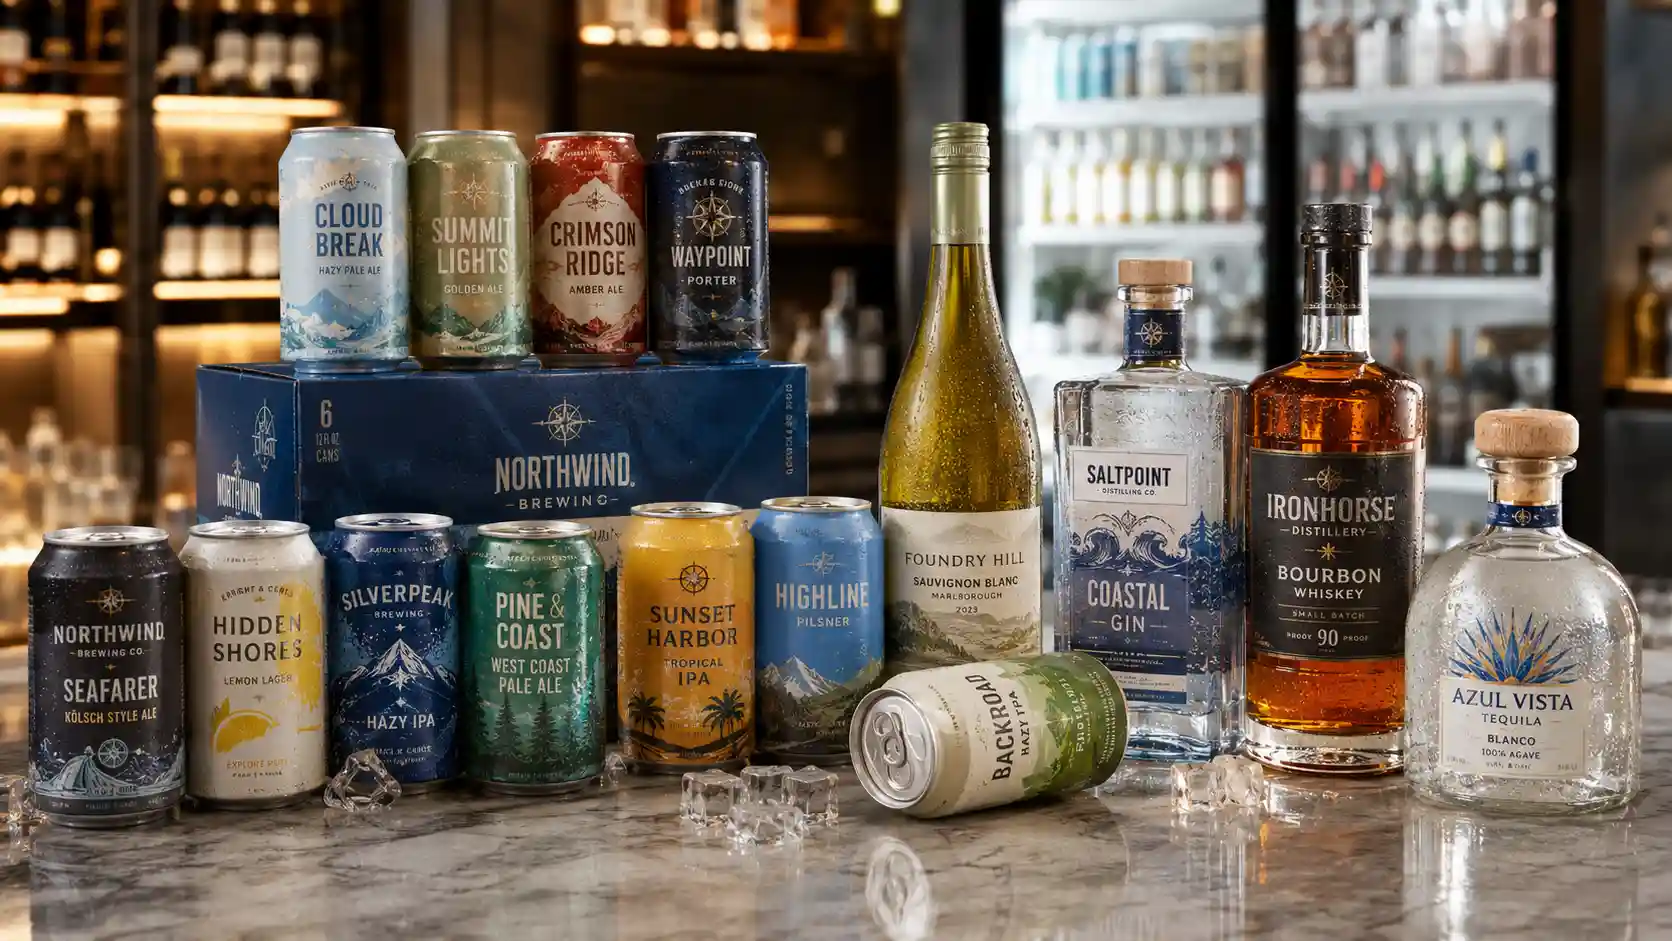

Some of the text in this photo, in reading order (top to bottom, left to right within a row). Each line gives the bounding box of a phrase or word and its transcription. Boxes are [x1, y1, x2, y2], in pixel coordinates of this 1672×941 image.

[316, 202, 382, 228] CLOUD
[432, 217, 512, 244] SUMMIT
[550, 222, 636, 247] CRIMSON
[316, 232, 383, 258] BREAK
[438, 248, 508, 274] LIGHTS
[566, 250, 626, 276] RIDGE
[671, 246, 752, 268] WAYPOINT
[319, 266, 381, 275] HAZY PALE ALE
[444, 284, 504, 294] GOLDEN ALE
[570, 285, 624, 294] AMBER ALE
[687, 276, 737, 286] PORTER
[320, 399, 332, 428] 6
[316, 448, 340, 462] CANS
[1087, 464, 1172, 487] SALTPOINT
[1102, 487, 1142, 496] DISTILLING
[1267, 493, 1396, 522] IRONHORSE
[1292, 526, 1368, 537] DISTILLERY
[905, 551, 1025, 567] FOUNDRY HILL
[913, 576, 1019, 588] SAUVIGNON BLANC
[1278, 565, 1381, 584] BOURBON
[342, 584, 455, 612] SILVERPEAK
[776, 582, 870, 611] HIGHLINE
[931, 592, 1002, 600] MARLBOROUGH
[1087, 579, 1170, 611] COASTAL
[1294, 587, 1364, 600] WHISKEY
[374, 610, 424, 618] BREWING
[496, 592, 565, 619] PINE &
[650, 604, 736, 624] SUNSET
[956, 606, 978, 614] 2023
[797, 616, 849, 628] PILSNER
[1111, 614, 1145, 633] GIN
[1292, 610, 1365, 620] SMALL BATCH
[213, 615, 302, 636] HIDDEN
[496, 622, 565, 650] COAST
[647, 627, 737, 648] HARBOR
[1317, 628, 1338, 647] 90
[78, 648, 145, 658] BREWING CO.
[213, 639, 302, 662] SHORES
[491, 658, 570, 674] WEST COAST
[664, 658, 723, 668] TROPICAL
[224, 674, 292, 686] LEMON LAGER
[499, 677, 562, 694] PALE ALE
[678, 671, 710, 686] IPA
[64, 675, 158, 704] SEAFARER
[1452, 688, 1574, 711] AZUL VISTA
[64, 706, 157, 724] KÖLSCH STYLE ALE
[367, 714, 436, 729] HAZY IPA
[1481, 713, 1542, 726] TEQUILA
[964, 674, 1014, 781] BACKROAD
[1019, 720, 1030, 756] HAZY
[1487, 734, 1536, 746] BLANCO
[1482, 748, 1540, 760] 100% AGAVE
